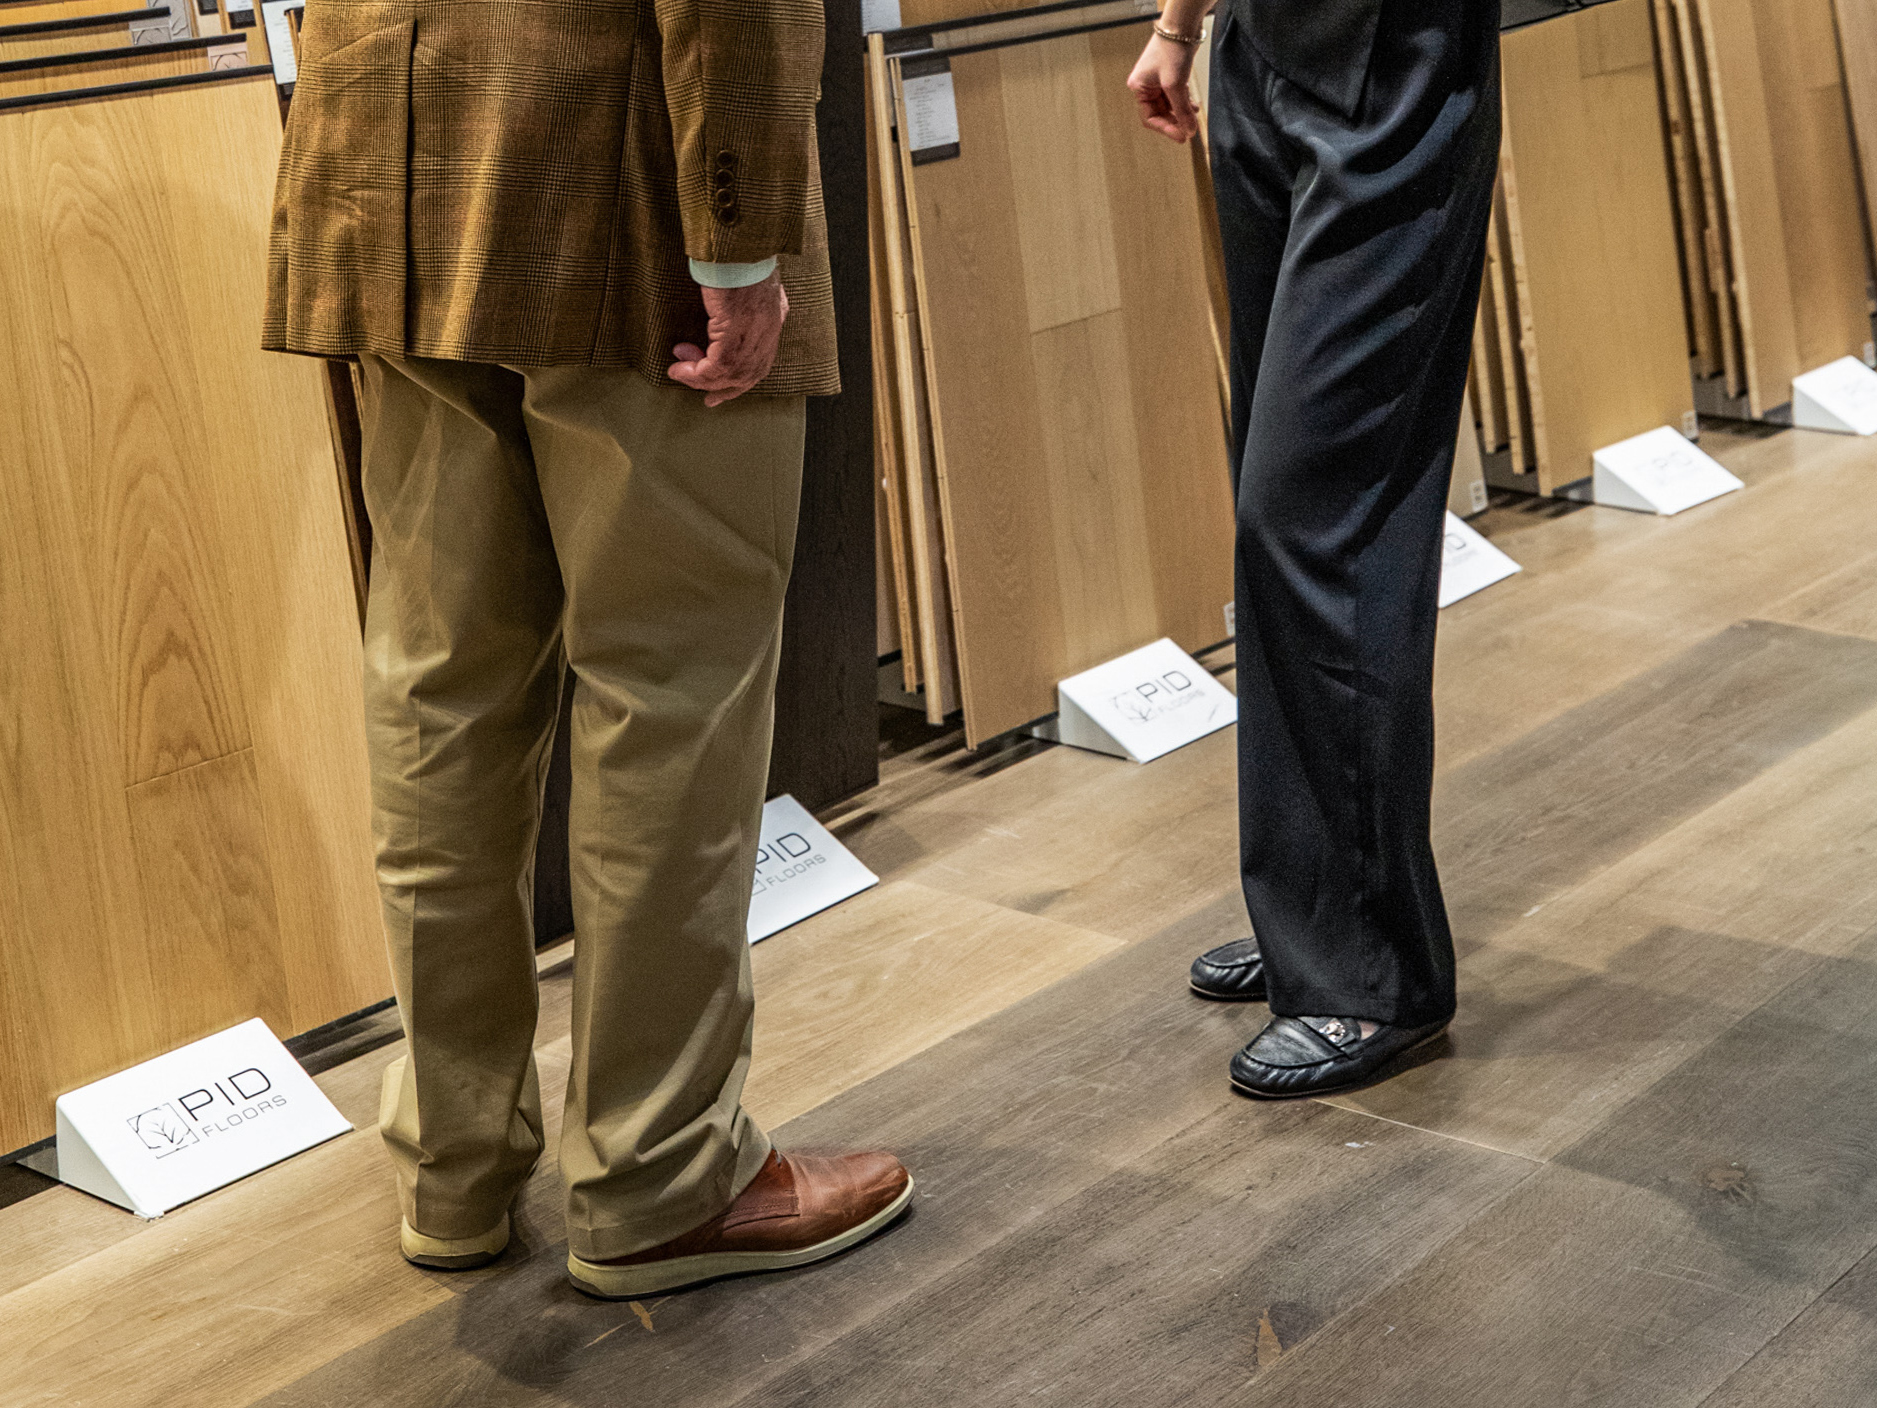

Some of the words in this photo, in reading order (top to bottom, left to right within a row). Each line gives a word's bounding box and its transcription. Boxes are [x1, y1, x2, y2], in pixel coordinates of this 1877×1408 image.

[1136, 670, 1192, 703] PID
[765, 853, 827, 887] FLOORS
[178, 1067, 271, 1122] PID
[202, 1095, 287, 1138] FLOORS
